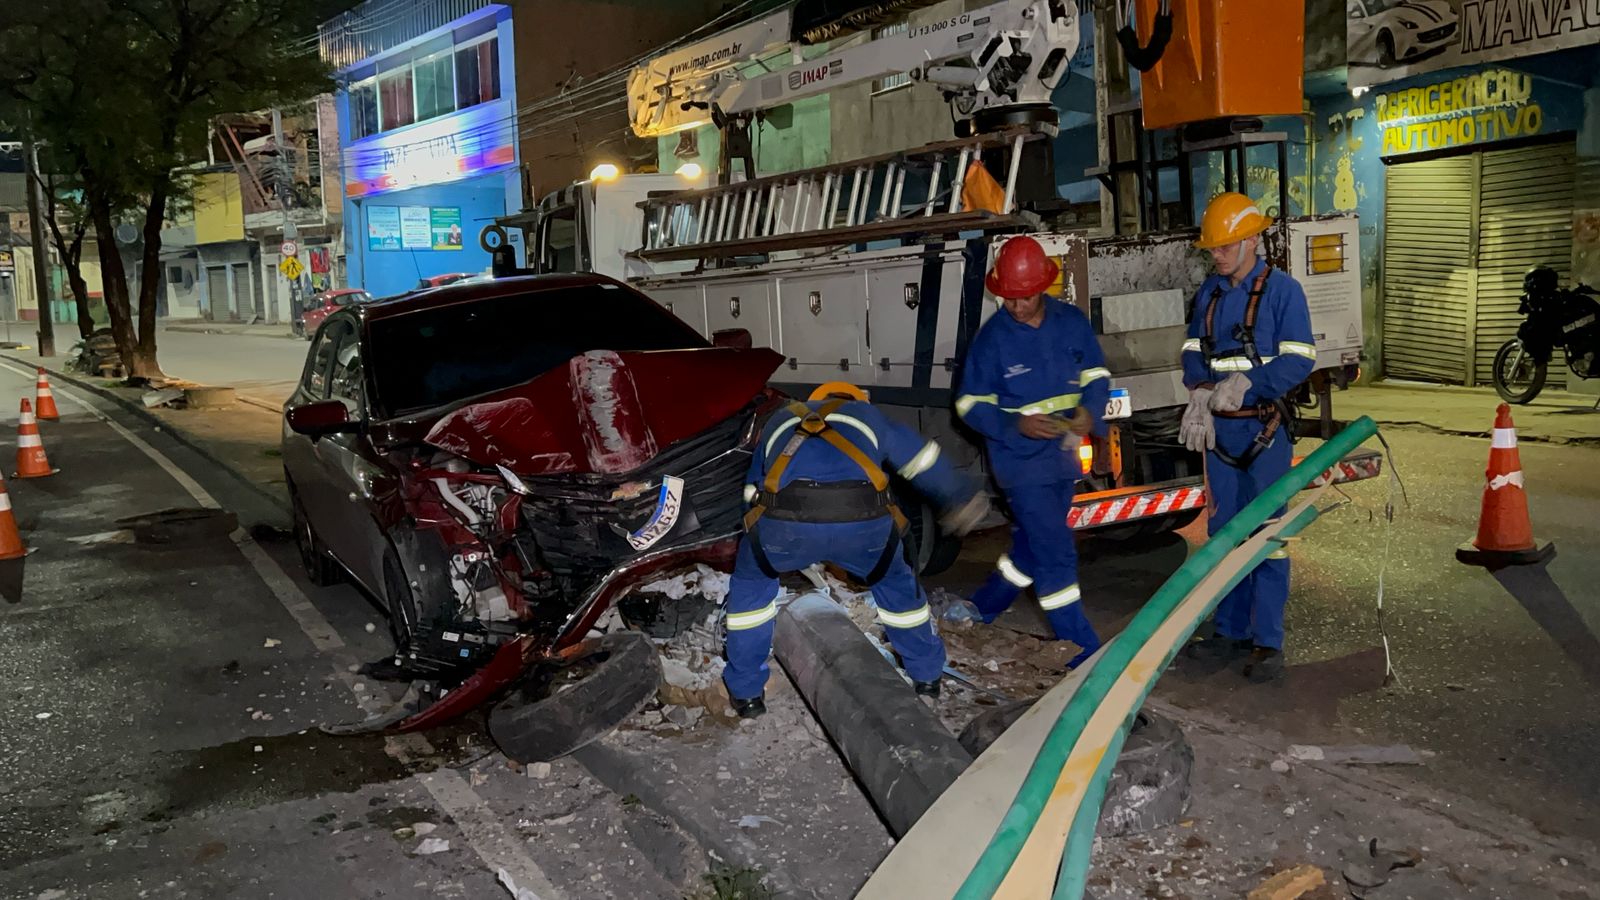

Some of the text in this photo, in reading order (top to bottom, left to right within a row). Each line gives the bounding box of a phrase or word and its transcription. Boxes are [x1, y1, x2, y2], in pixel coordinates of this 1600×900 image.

[950, 18, 956, 27] S
[960, 15, 970, 25] GI
[669, 42, 742, 76] www.imap.com.br
[802, 65, 828, 86] IMAP
[1382, 104, 1542, 155] AUTOMOTIVO
[283, 244, 295, 252] 40
